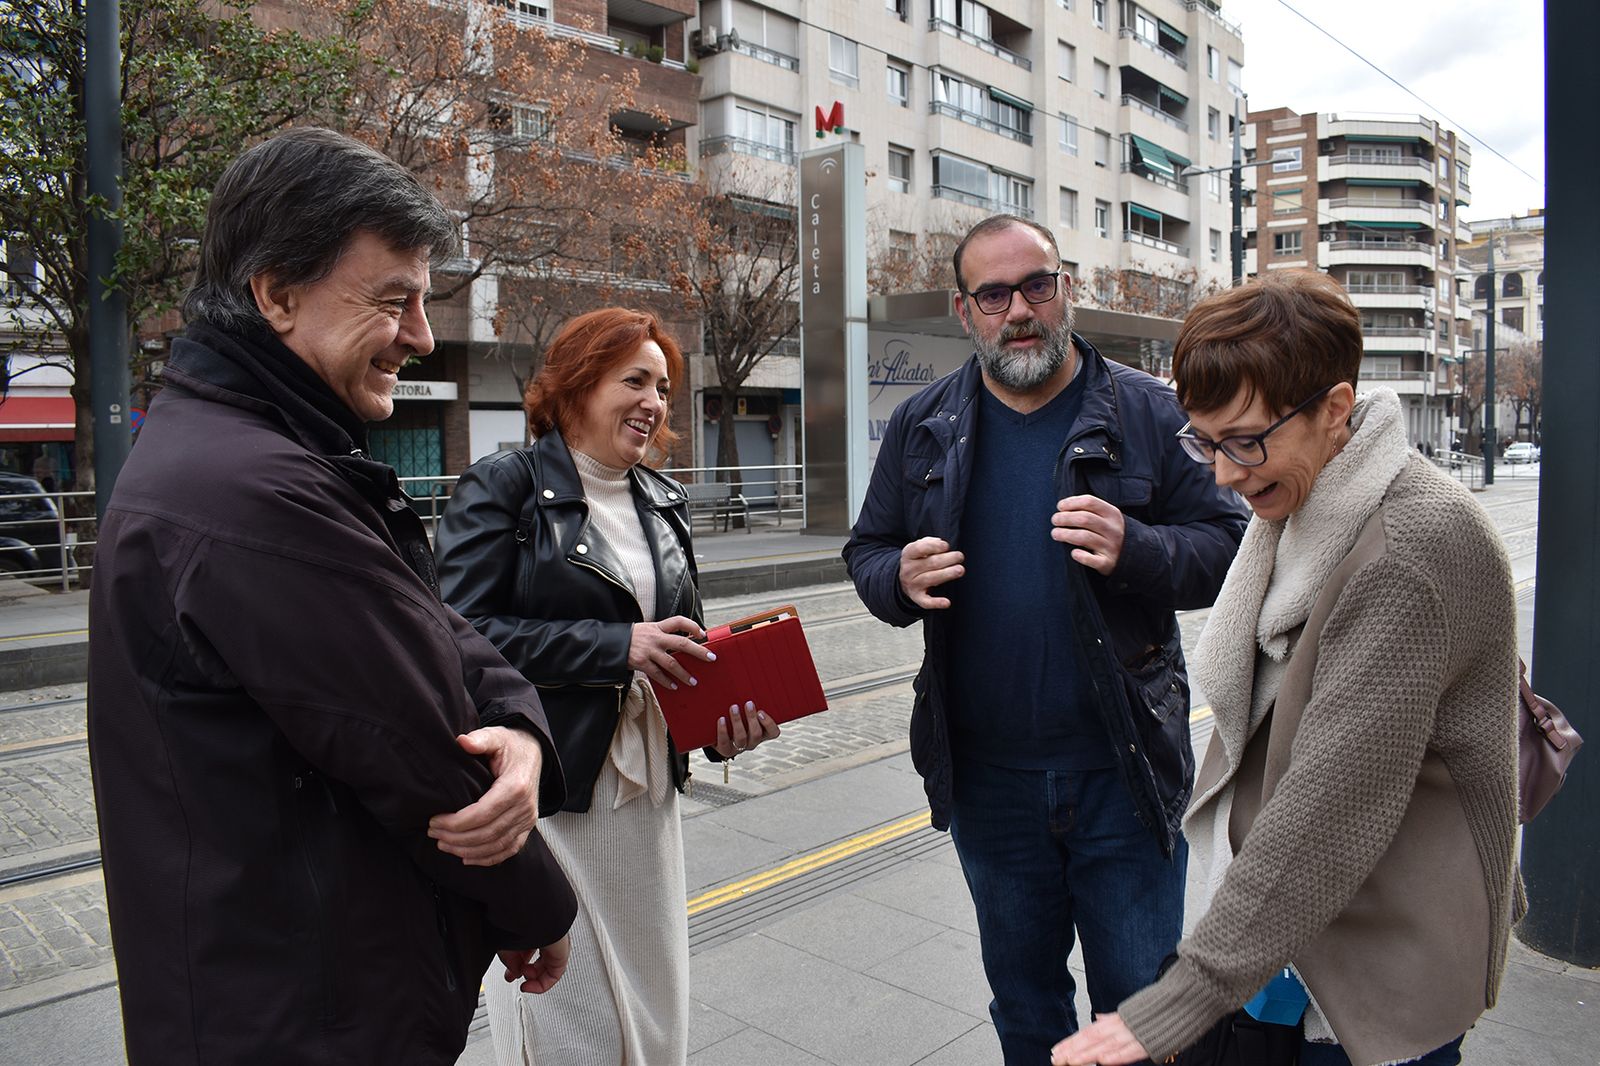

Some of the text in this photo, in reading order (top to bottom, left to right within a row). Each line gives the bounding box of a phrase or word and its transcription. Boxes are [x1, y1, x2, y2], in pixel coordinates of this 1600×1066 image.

[815, 100, 845, 139] M
[811, 193, 821, 295] Caleta
[880, 339, 937, 388] Aliatar
[391, 384, 432, 396] STORIA
